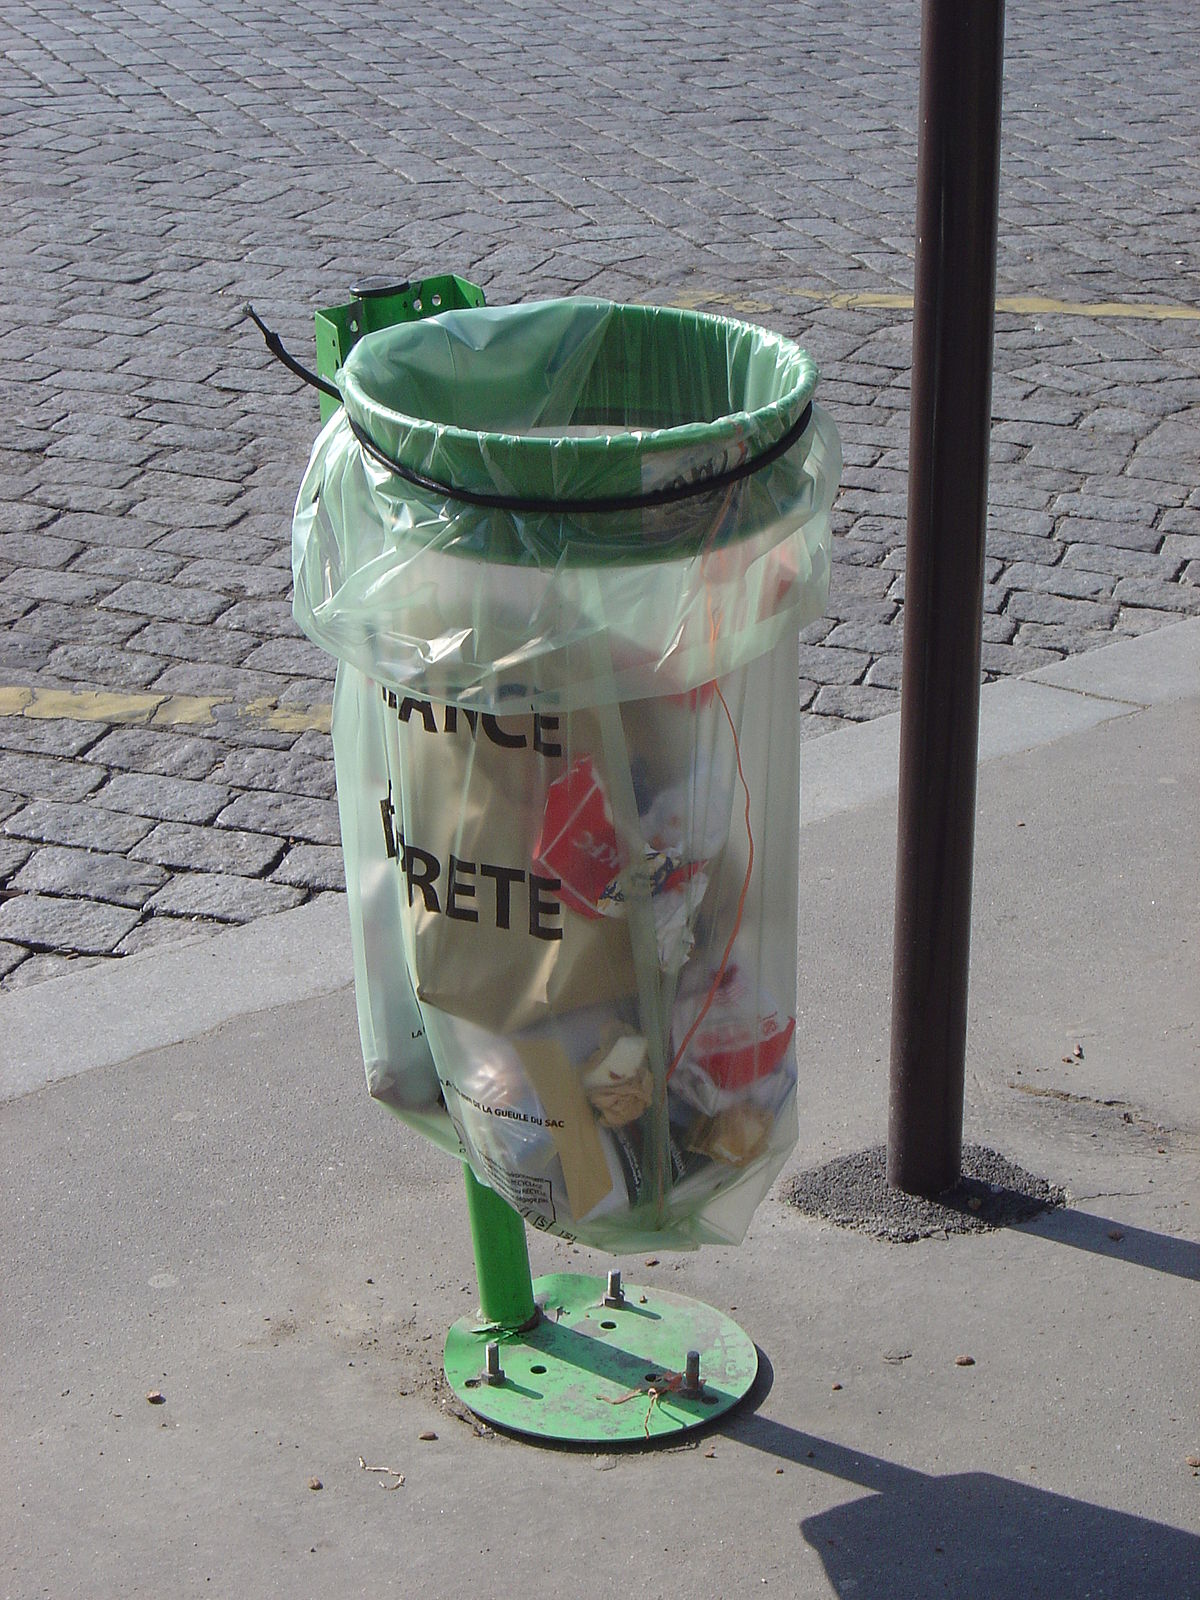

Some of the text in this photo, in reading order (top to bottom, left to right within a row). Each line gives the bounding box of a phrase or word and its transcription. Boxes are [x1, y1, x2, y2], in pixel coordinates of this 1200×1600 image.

[482, 1104, 493, 1116] LA
[494, 1108, 529, 1122] GUEULE
[530, 1115, 543, 1126] DU
[545, 1118, 565, 1128] SAC
